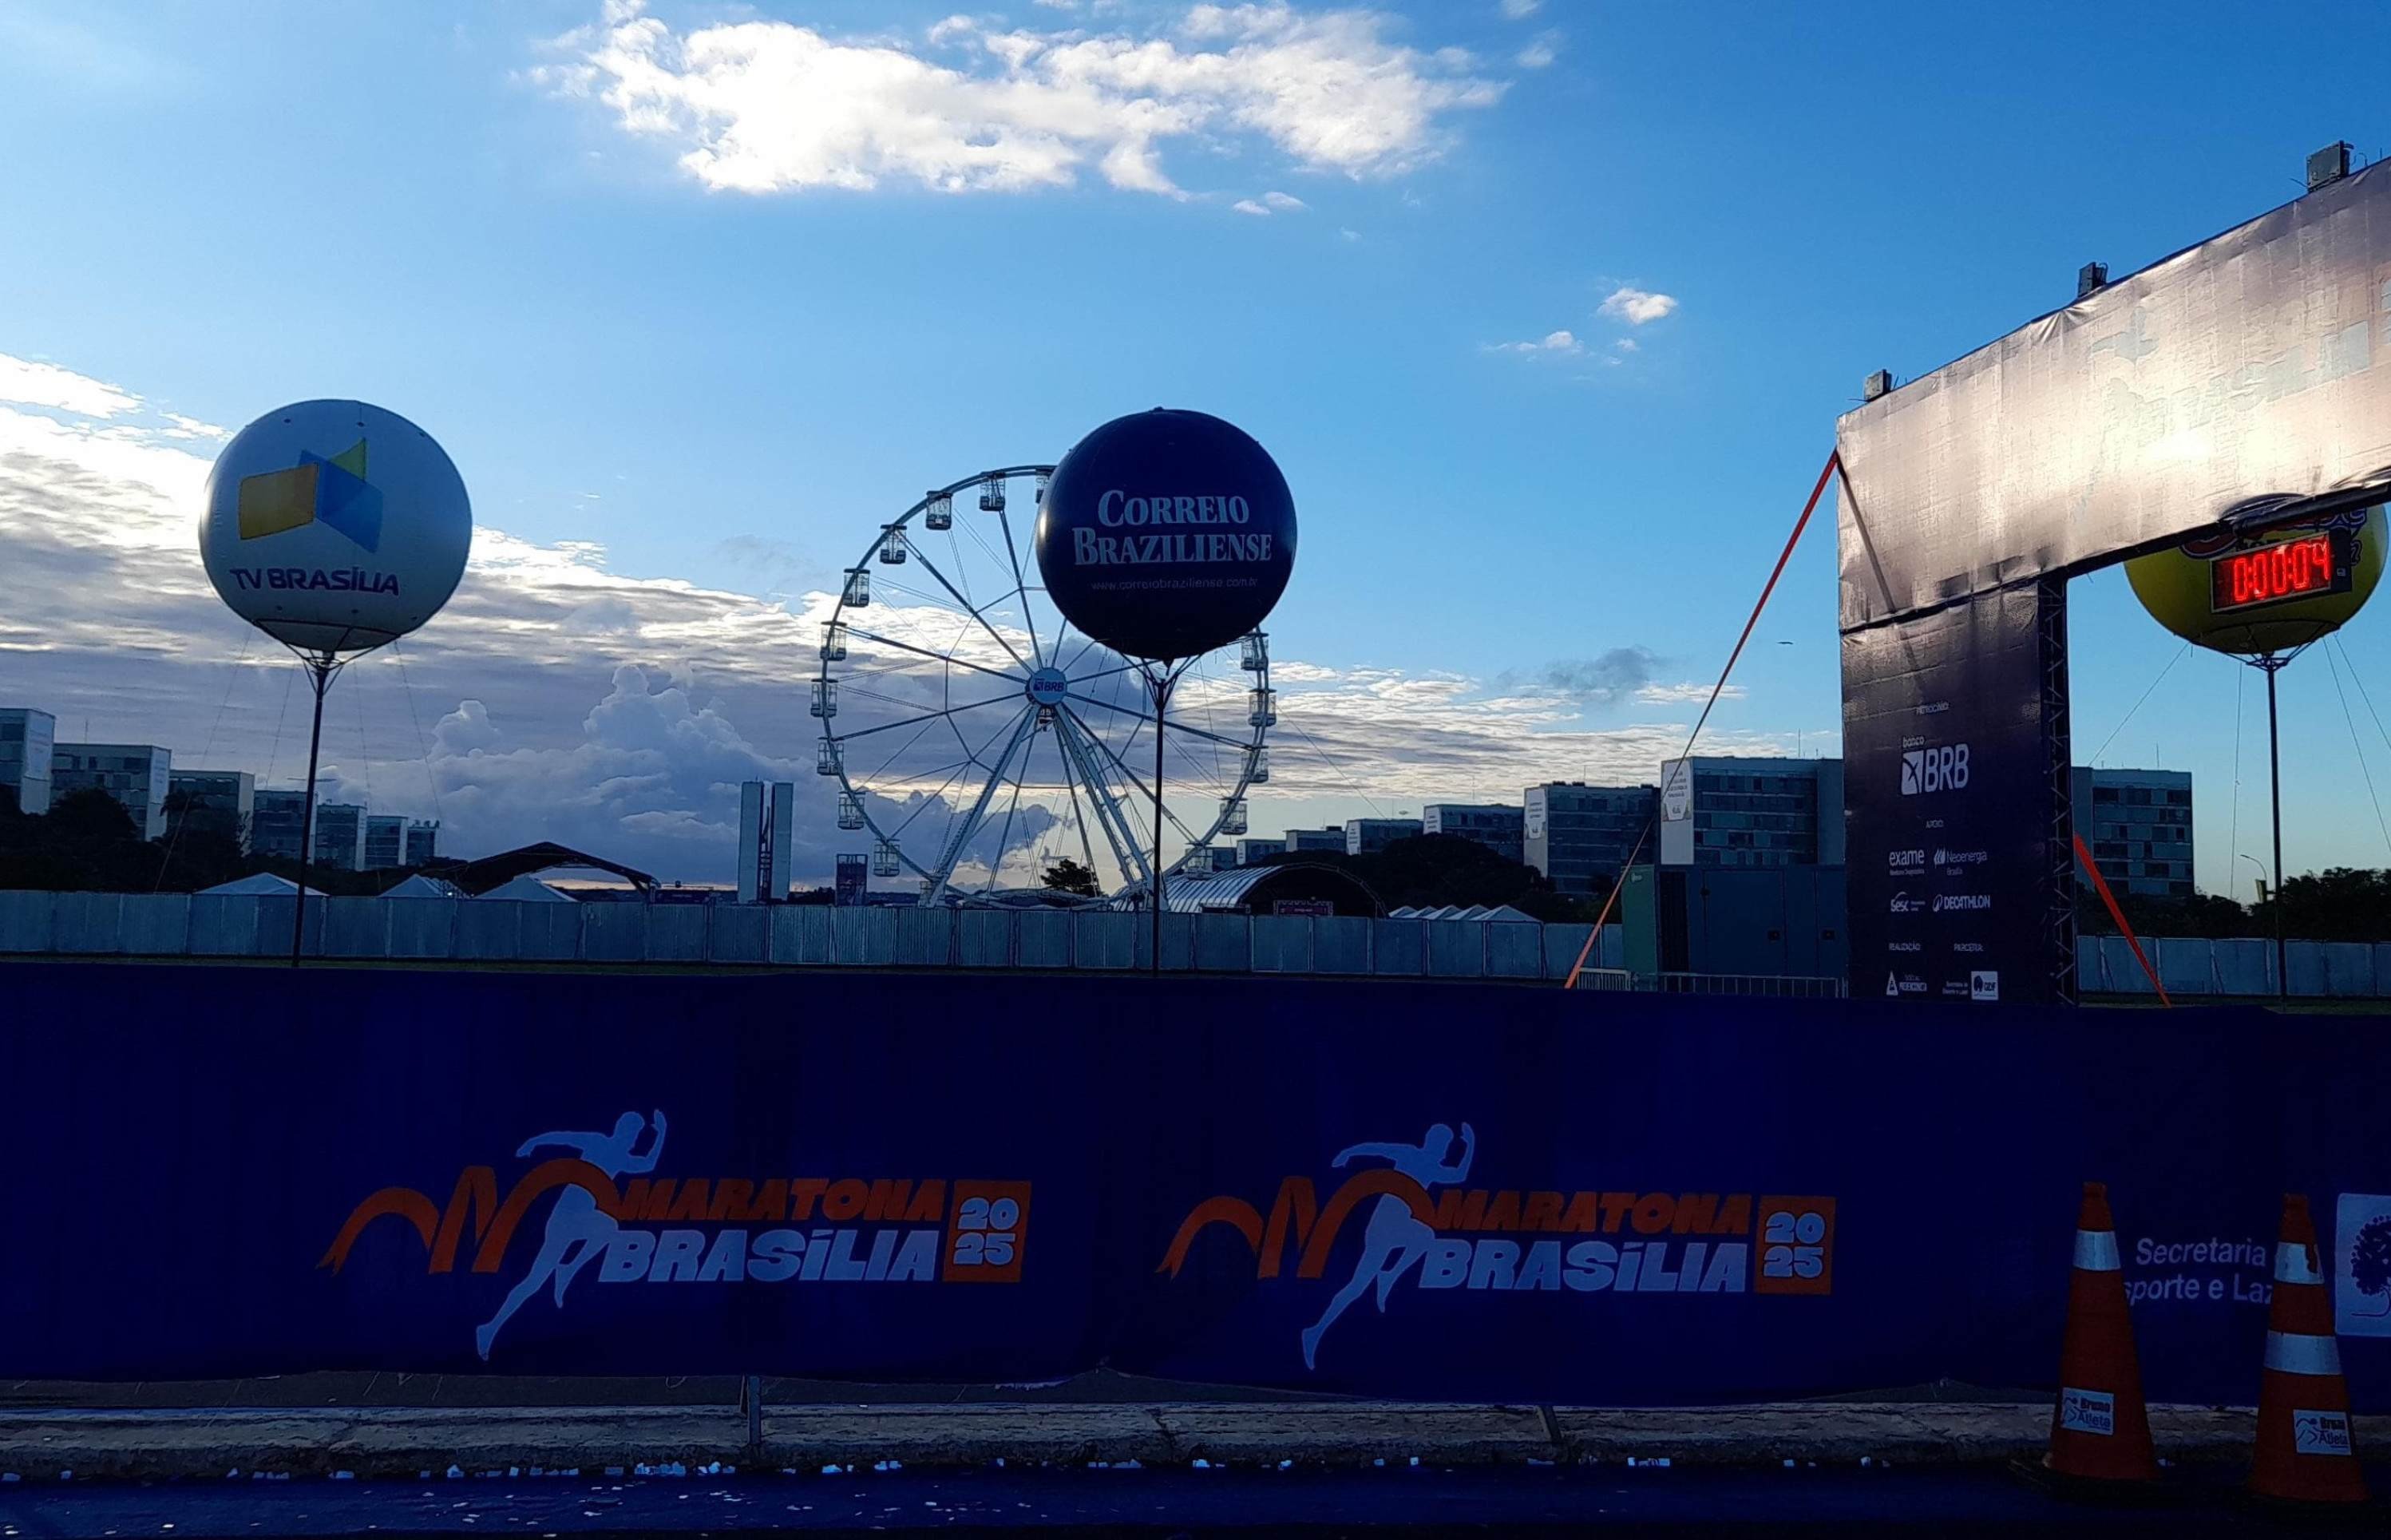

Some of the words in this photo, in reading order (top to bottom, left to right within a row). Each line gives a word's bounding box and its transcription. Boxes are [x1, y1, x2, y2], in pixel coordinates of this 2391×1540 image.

[1098, 489, 1249, 527] CORREIO
[1071, 527, 1273, 565] BRAZILIENSE
[229, 568, 263, 591] TV
[1043, 681, 1065, 692] BRB
[1902, 735, 1925, 748] banco
[1924, 742, 1970, 793] BRB
[1889, 849, 1926, 867] exame
[1943, 894, 1992, 911] DECATHLON
[620, 1177, 947, 1221] MARATONA
[957, 1196, 1021, 1230] 20
[1437, 1189, 1752, 1234] MARATONA
[1764, 1210, 1827, 1244] 20
[952, 1232, 1016, 1265] 25
[1762, 1245, 1825, 1279] 25
[2135, 1237, 2267, 1267] Secretaria
[2123, 1273, 2200, 1307] sporte
[2207, 1281, 2224, 1300] e
[2233, 1273, 2273, 1305] Laz
